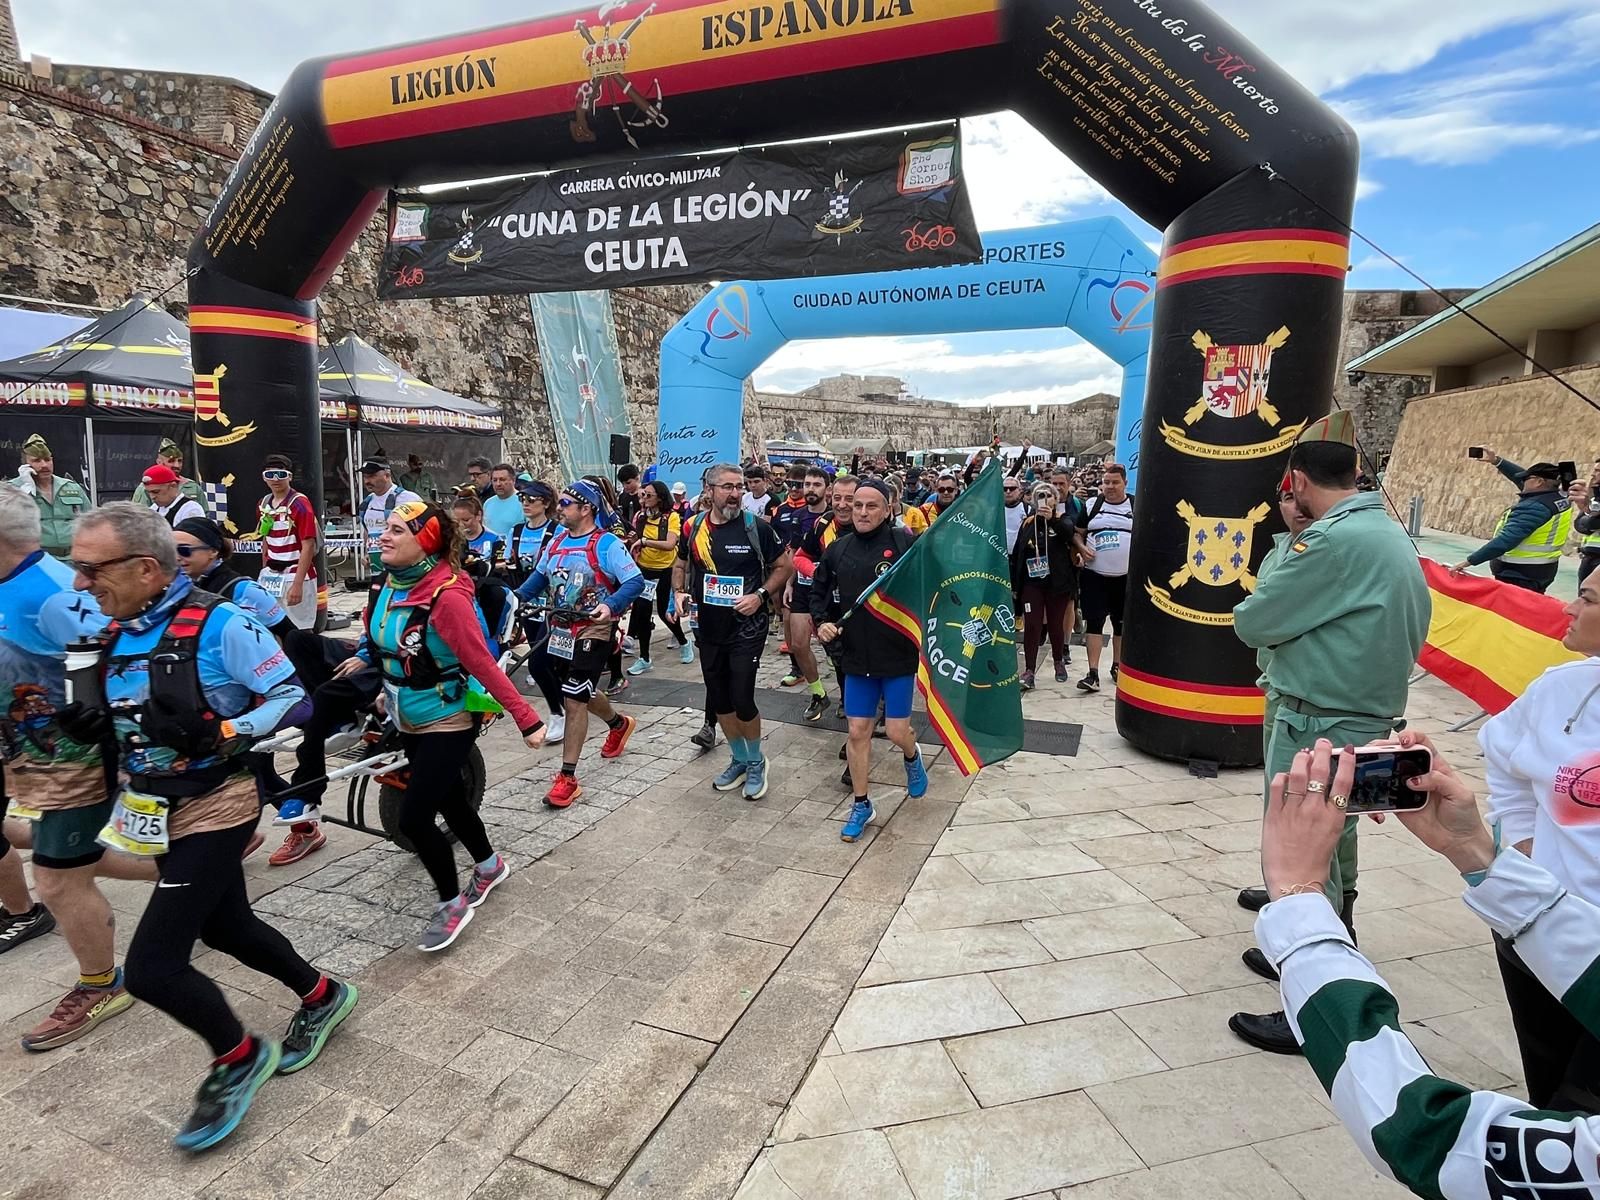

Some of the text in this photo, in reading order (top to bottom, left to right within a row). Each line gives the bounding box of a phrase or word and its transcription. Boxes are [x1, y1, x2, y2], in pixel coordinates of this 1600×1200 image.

[1071, 12, 1209, 136] No se muere más que una vez.
[1102, 17, 1115, 29] en
[1116, 28, 1133, 41] el
[1125, 37, 1164, 69] combate
[1164, 69, 1176, 79] es
[1175, 79, 1194, 92] el
[1186, 87, 1219, 113] mayor
[1218, 112, 1249, 141] honor.
[1162, 19, 1187, 35] de
[1182, 34, 1205, 51] la
[1204, 46, 1279, 115] Muerte
[390, 56, 497, 105] LEGIÓN
[1046, 16, 1210, 161] La muerte llega sin dolor y el morir
[1037, 57, 1053, 79] Lo
[1054, 79, 1072, 95] más
[1072, 92, 1109, 127] horrible
[1109, 127, 1119, 136] es
[1121, 135, 1143, 156] vivir
[1047, 50, 1181, 167] no es tan horrible como parece.
[1074, 117, 1086, 129] un
[909, 174, 938, 185] Shop
[911, 161, 950, 174] Corner
[560, 166, 721, 196] CARRERA CÍVICO-MILITAR
[587, 206, 621, 233] DE
[629, 202, 663, 227] LA
[584, 236, 688, 273] CEUTA
[979, 241, 1066, 265] PORTES
[793, 278, 1046, 308] CIUDAD AUTÓNOMA DE CEUTA
[92, 383, 182, 409] TERCIO
[361, 404, 409, 424] TERCIO
[457, 413, 471, 429] DE
[701, 425, 718, 439] es
[658, 450, 719, 473] Deporte
[1259, 446, 1267, 454] DE
[1268, 444, 1276, 452] LA
[716, 584, 741, 596] 1906
[940, 570, 981, 588] RETIRADOS
[927, 616, 969, 684] RAGCE
[1555, 774, 1599, 791] SPORTS
[1557, 766, 1582, 777] NIKE
